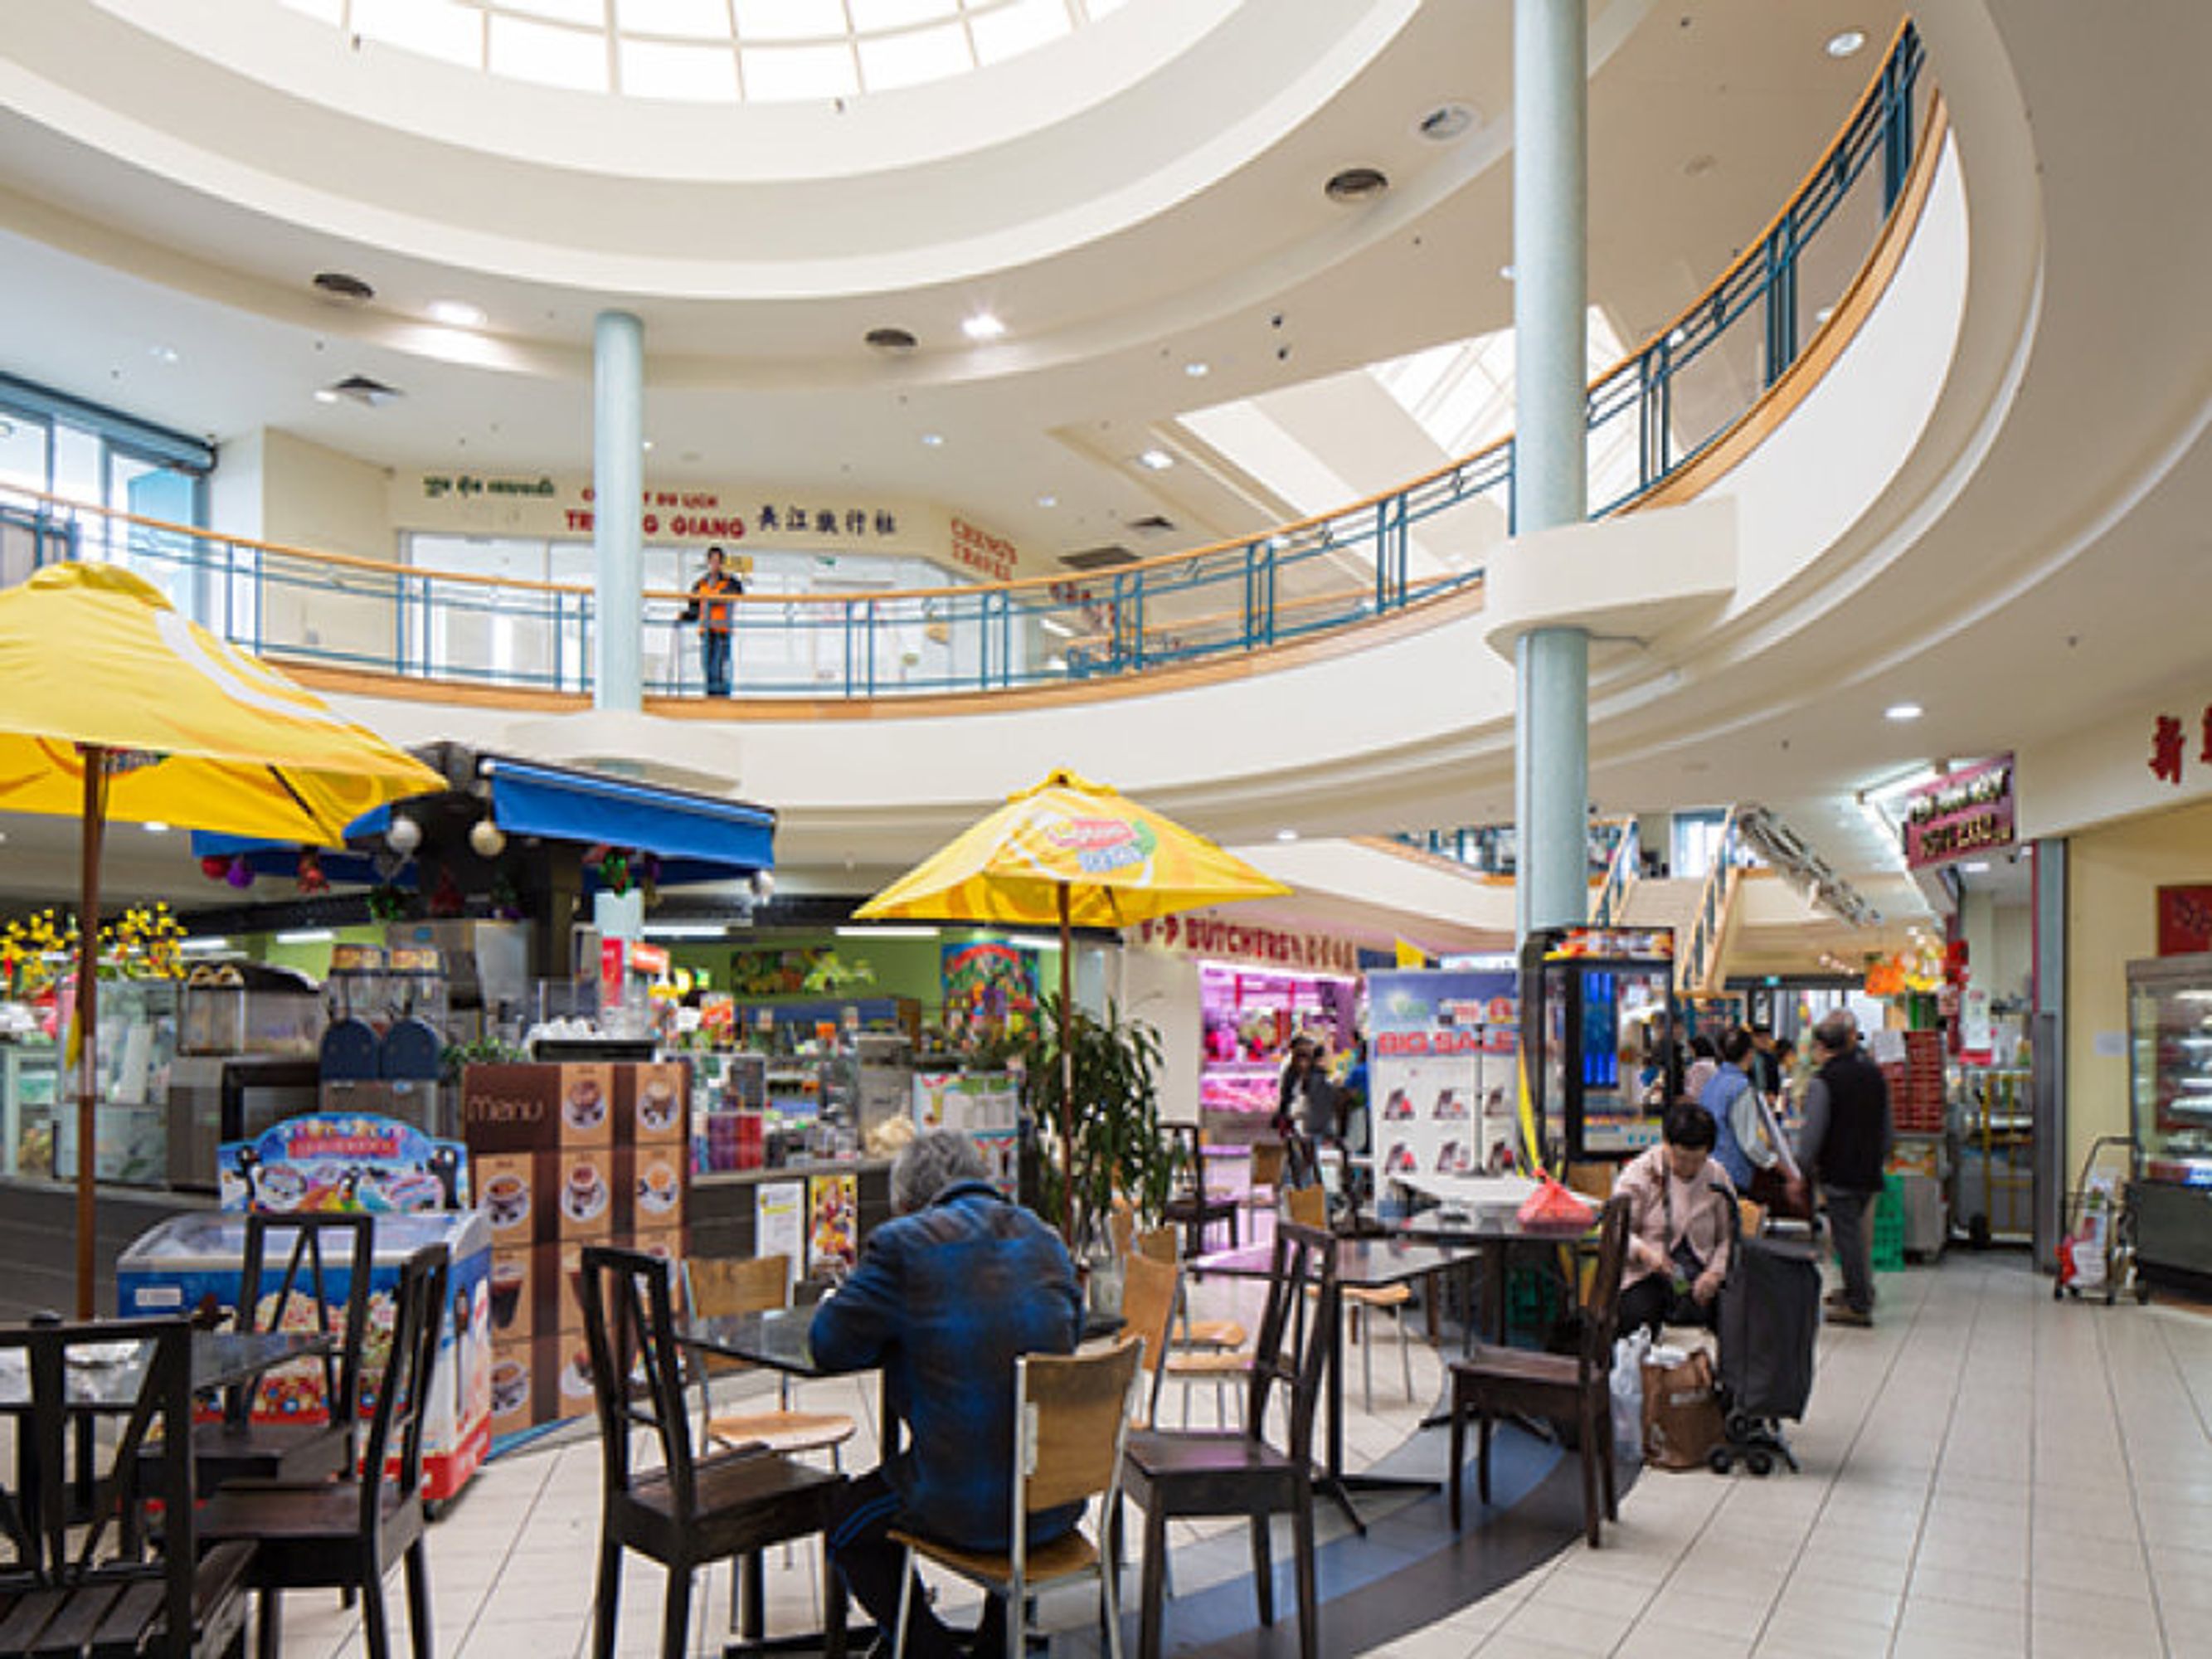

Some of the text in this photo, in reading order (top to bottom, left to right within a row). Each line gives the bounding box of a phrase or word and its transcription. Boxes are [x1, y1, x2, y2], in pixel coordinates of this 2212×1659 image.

[669, 514, 745, 538] GIANG
[1186, 917, 1291, 961] BUTCHERS
[1377, 1031, 1429, 1055] BIG
